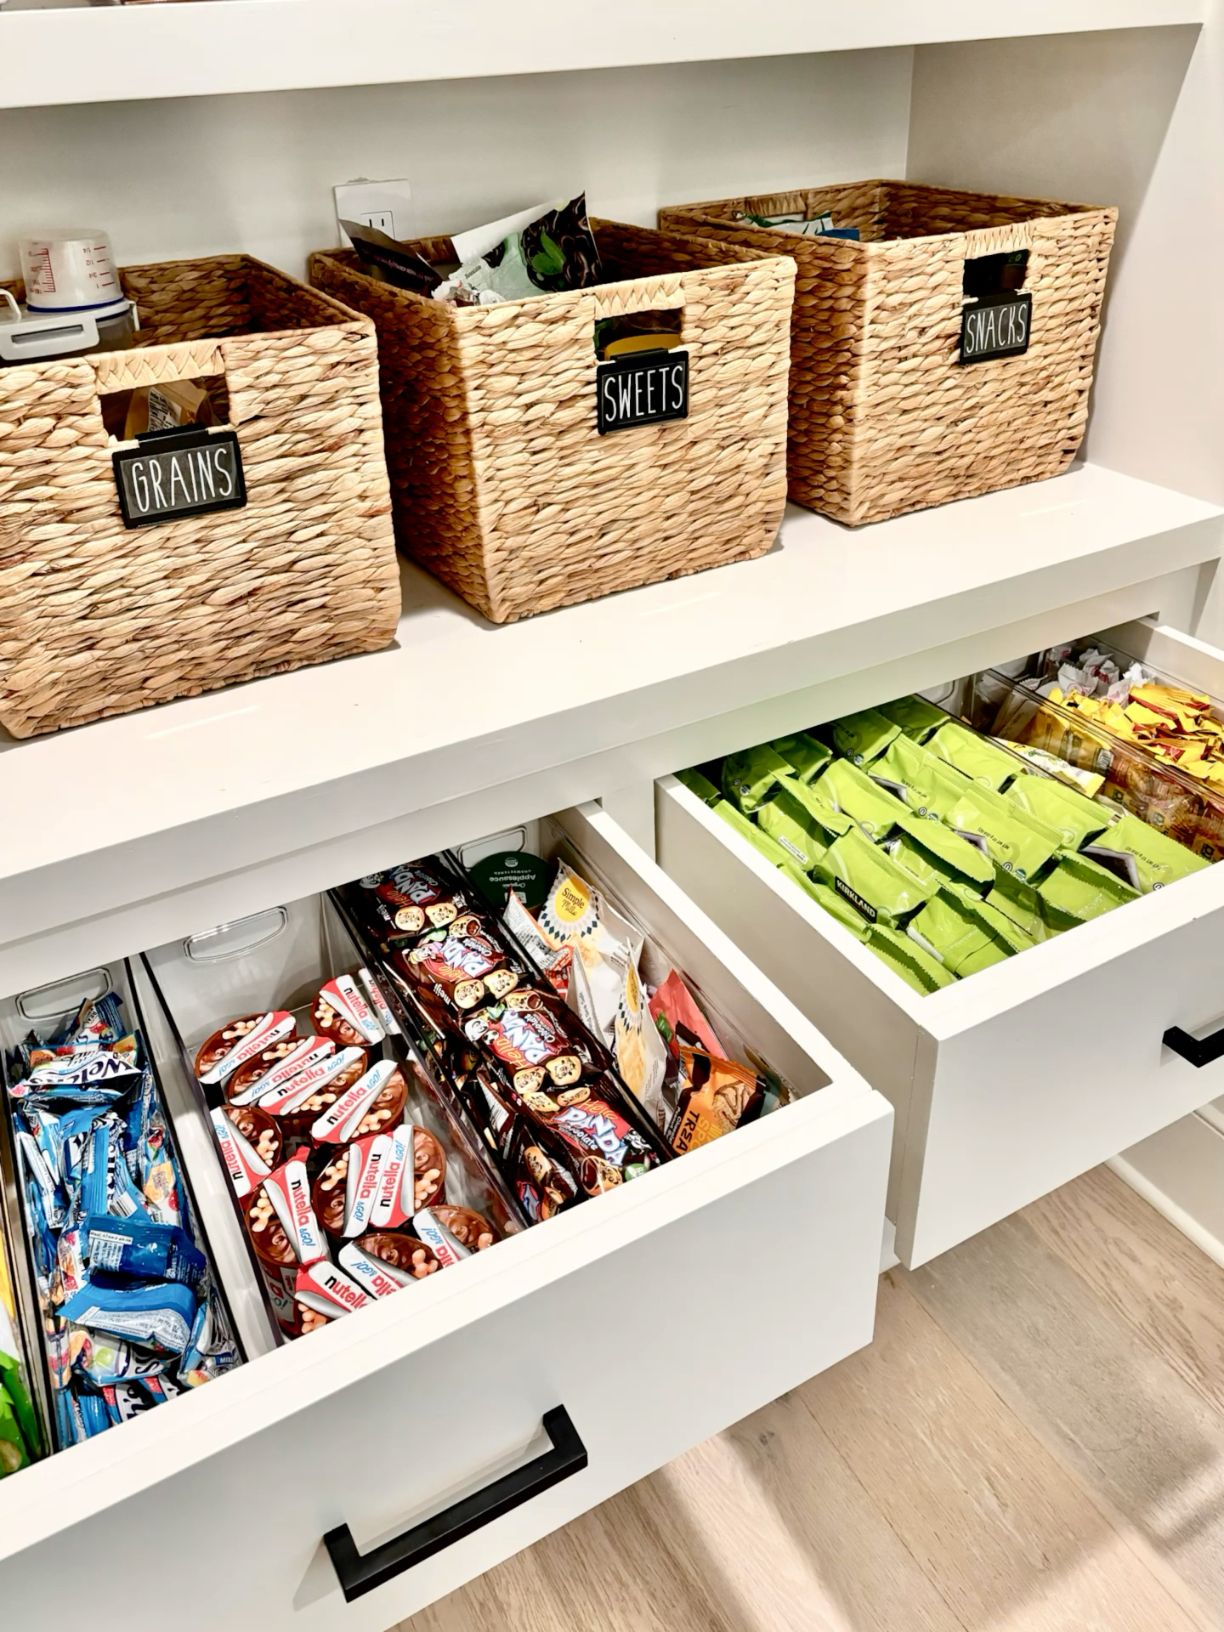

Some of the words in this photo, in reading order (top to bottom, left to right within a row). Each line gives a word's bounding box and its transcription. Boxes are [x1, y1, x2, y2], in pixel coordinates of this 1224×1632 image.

[966, 303, 1027, 354] SNACKS
[604, 365, 684, 422] SWEETS
[132, 447, 233, 513] GRAINS
[562, 887, 585, 909] Simple
[836, 879, 876, 918] KIRKLAND
[441, 935, 495, 978] PANDA
[344, 987, 369, 1019] nutella
[236, 1029, 280, 1061] nutella
[497, 1036, 529, 1070] Hello
[499, 1009, 553, 1065] PANDA
[271, 1053, 319, 1084] nutella
[277, 1066, 326, 1097] nutella
[326, 1085, 367, 1126] nutella
[578, 1098, 619, 1122] Hello
[554, 1106, 628, 1166] PANDA
[220, 1140, 244, 1181] nutella
[360, 1153, 382, 1199] nutella
[291, 1179, 312, 1227] nutella
[379, 1161, 400, 1208] nutella
